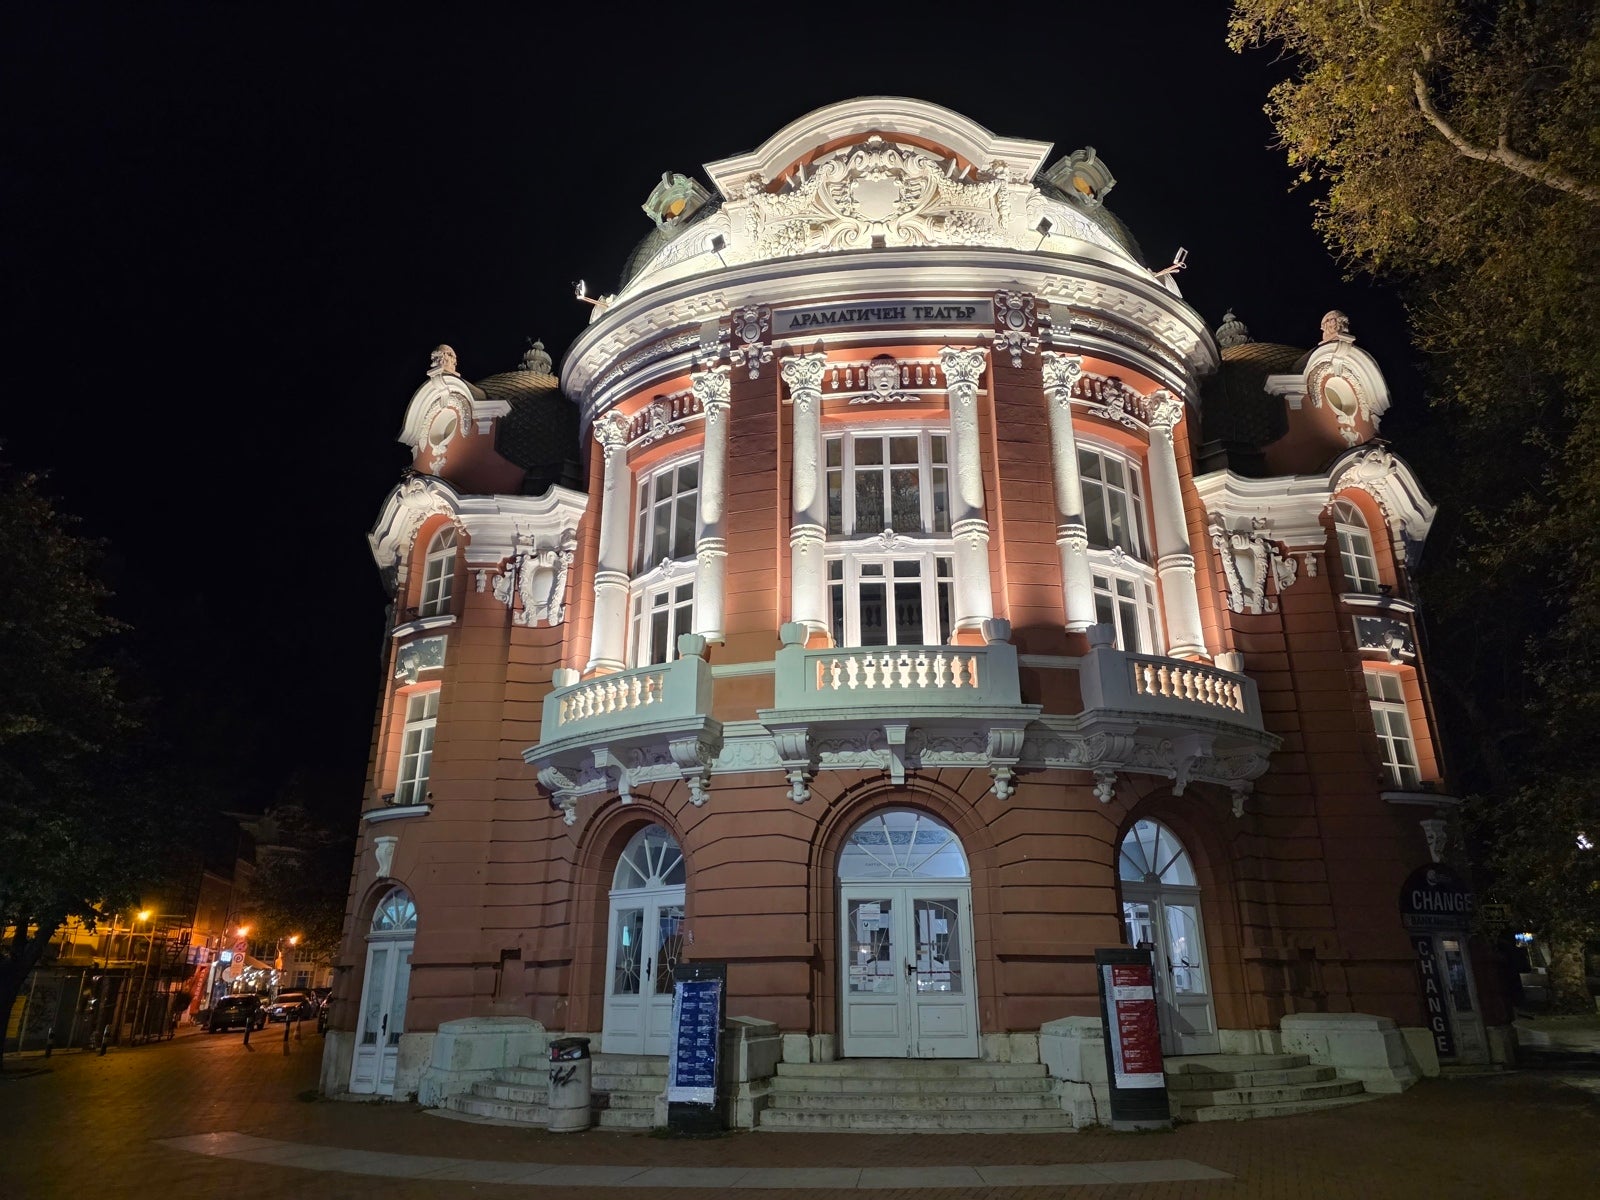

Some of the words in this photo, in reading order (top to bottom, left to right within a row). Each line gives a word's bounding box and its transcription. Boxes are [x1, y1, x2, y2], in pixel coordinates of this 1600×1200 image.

[789, 306, 906, 328] ДРАМАТИЧЕН
[912, 306, 976, 320] ТЕАТЪР
[1412, 890, 1473, 912] CHANGE
[1418, 941, 1449, 1051] CHANGE
